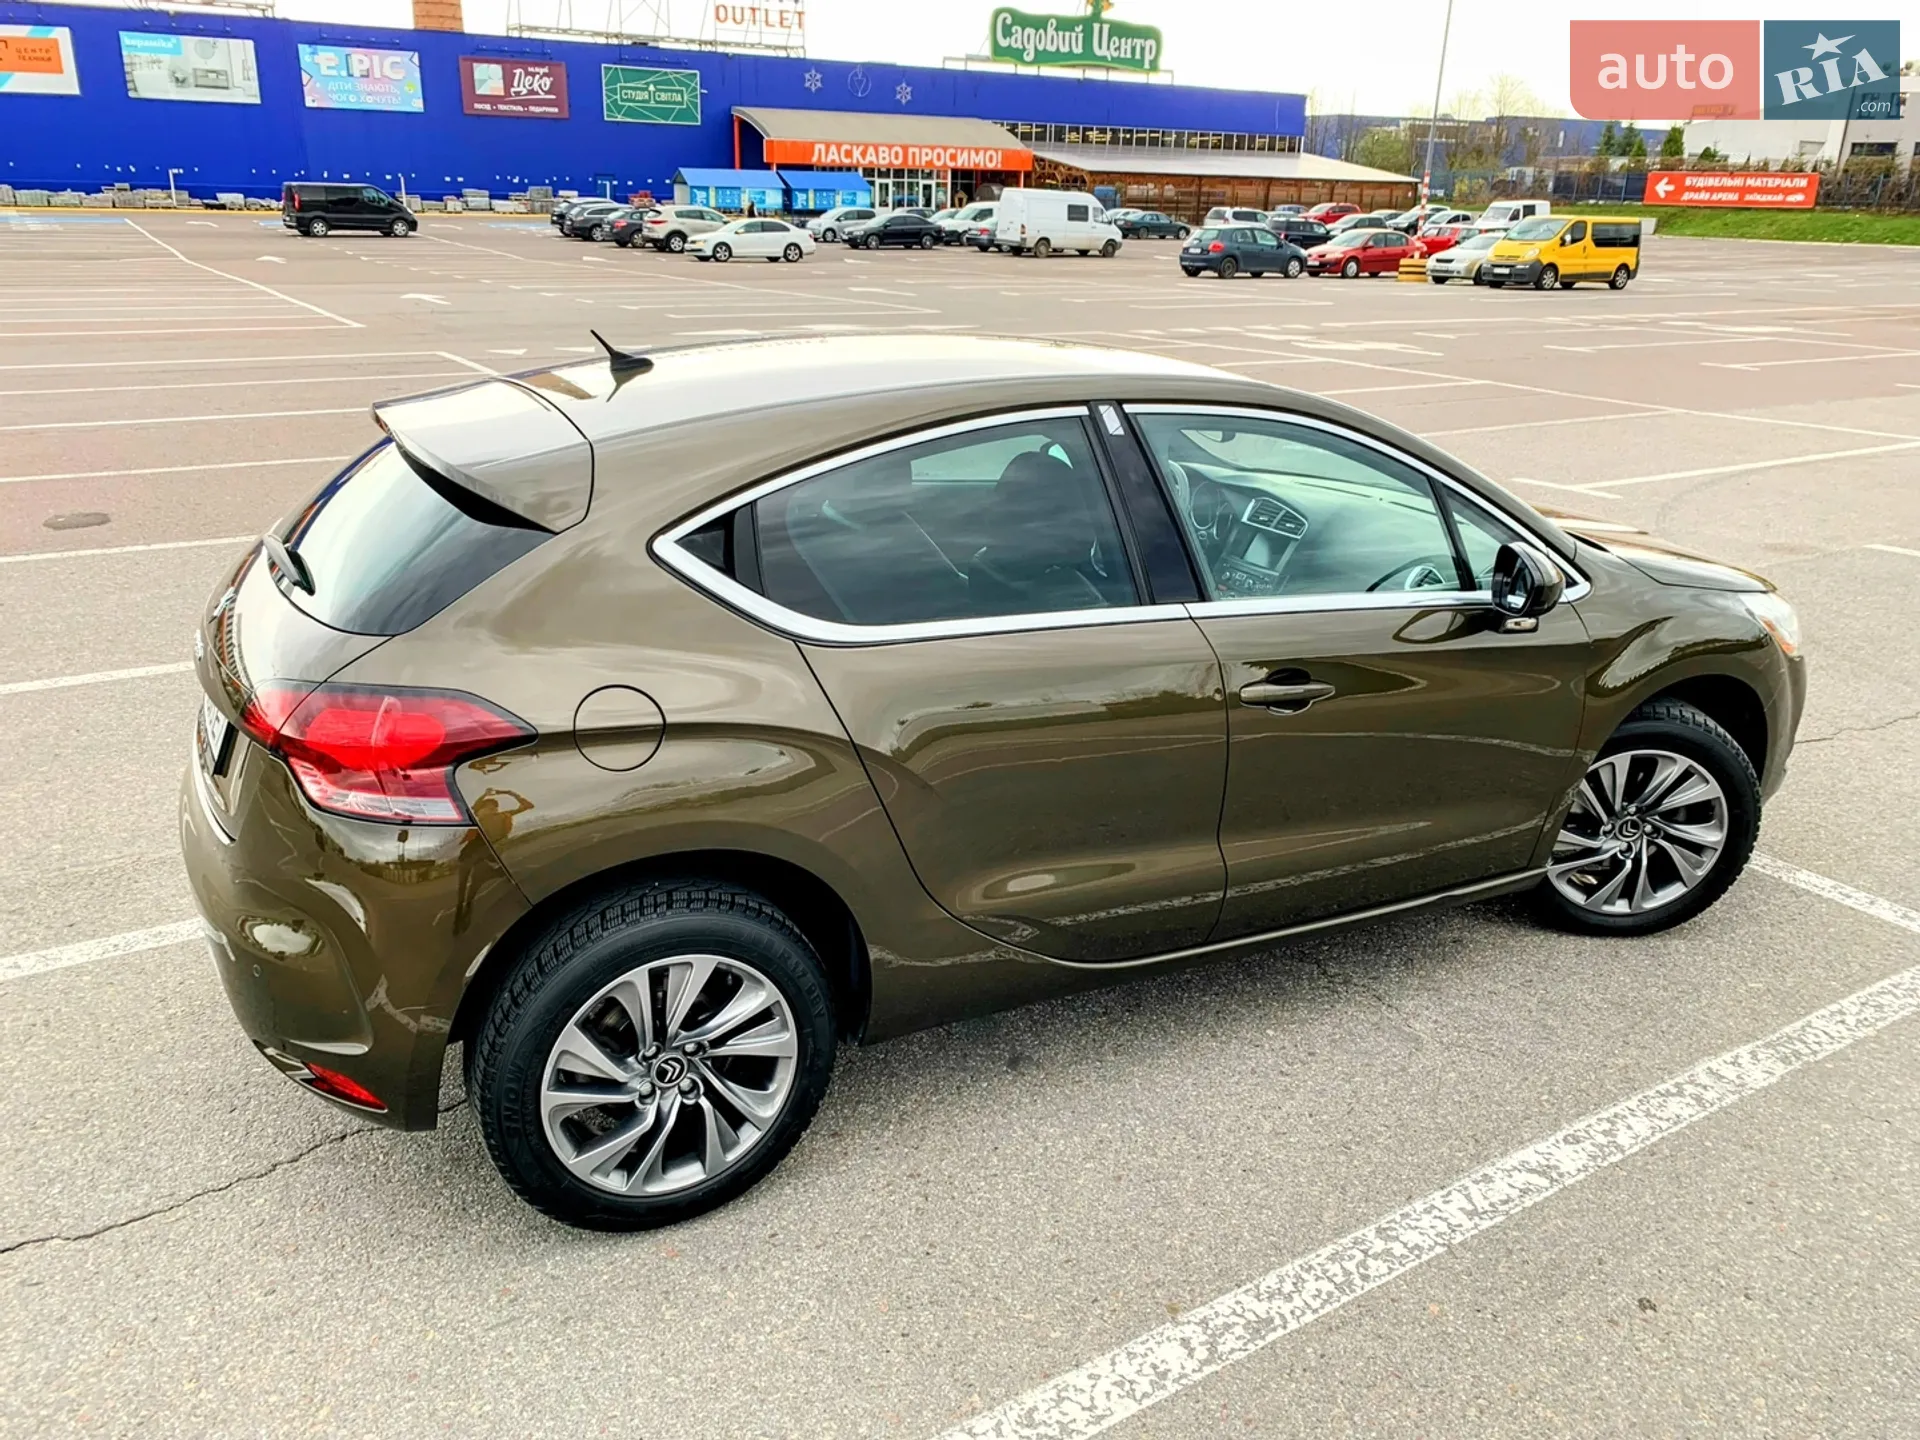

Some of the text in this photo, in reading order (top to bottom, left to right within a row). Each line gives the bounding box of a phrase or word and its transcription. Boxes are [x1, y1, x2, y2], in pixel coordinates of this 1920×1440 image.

[715, 4, 805, 29] OUTLET
[995, 11, 1158, 68] Садовий Центр
[327, 80, 352, 92] ДІТИ
[510, 68, 553, 97] Деко
[328, 93, 357, 103] ЧОГО
[620, 89, 683, 103] СТУДІЯ СВІТЛА
[811, 143, 1004, 169] ЛАСКАВО ПРОСИМО!
[1684, 175, 1809, 188] БУДІВЕЛЬНІ МАТЕРІАЛИ
[1710, 192, 1740, 202] АРЕНА
